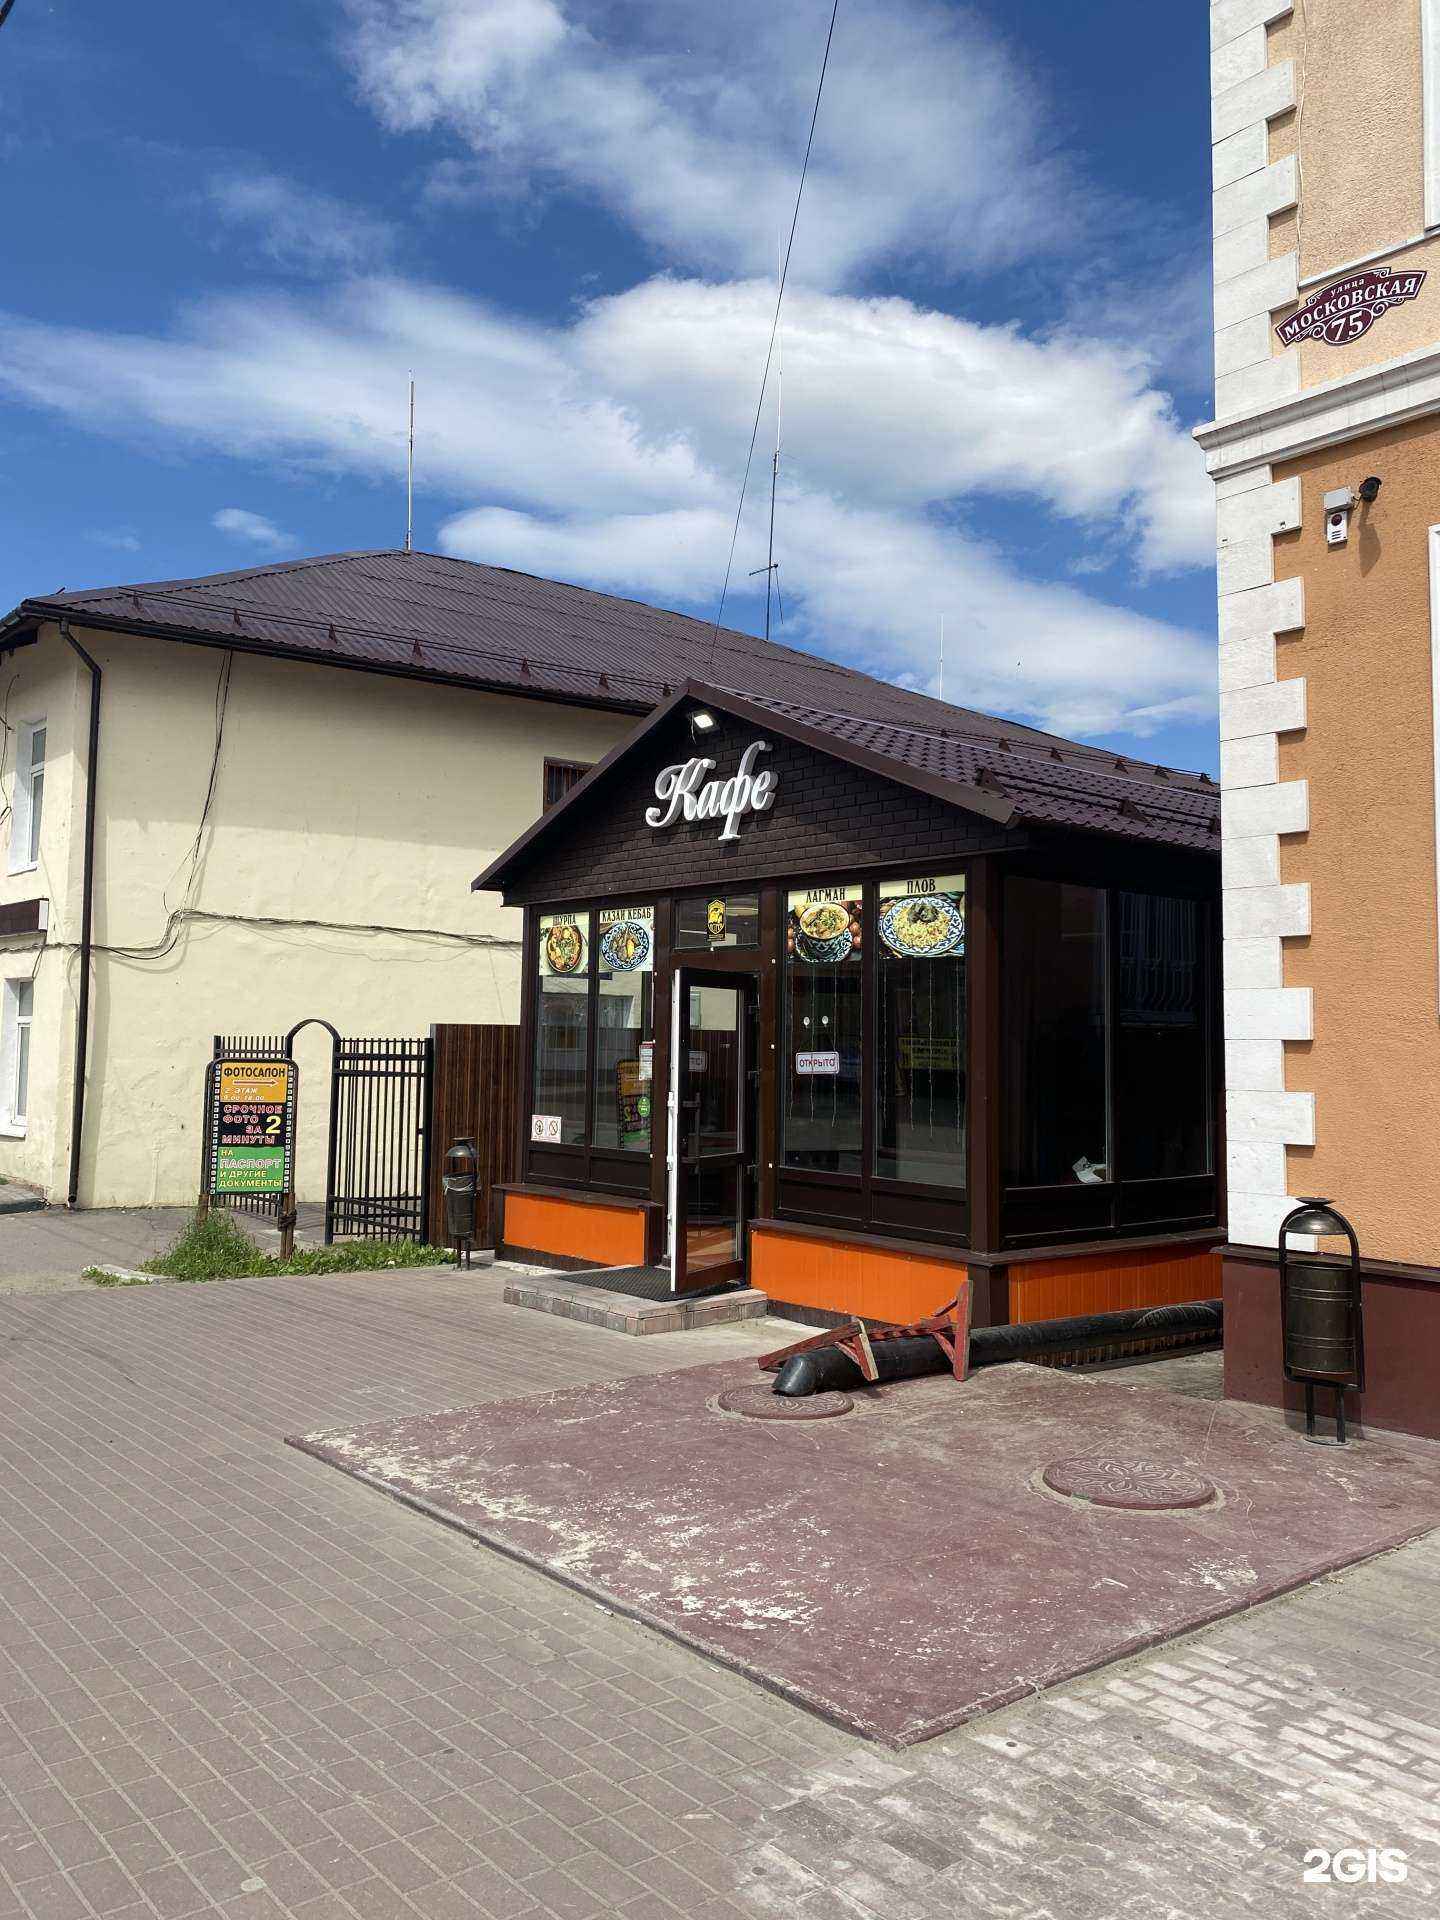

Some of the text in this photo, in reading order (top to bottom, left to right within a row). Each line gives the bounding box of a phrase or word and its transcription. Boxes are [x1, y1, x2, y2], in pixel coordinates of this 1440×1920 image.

[1330, 278, 1365, 298] улица
[1284, 277, 1418, 339] МОСКОВСКАЯ
[1330, 311, 1363, 341] 75
[645, 740, 778, 841] Кафе
[906, 878, 936, 894] ПЛОВ
[805, 888, 846, 903] ЛАГМАН
[602, 907, 652, 922] КАЗАН КЕБАБ
[799, 1057, 836, 1067] ОТКРЫТО
[224, 1066, 286, 1078] ФОТОСАЛОН
[223, 1104, 283, 1114] СРОЧНОЕ
[222, 1114, 259, 1124] ФОТО
[245, 1115, 282, 1134] ЗА 2
[221, 1134, 275, 1145] МИНУТЫ
[219, 1158, 281, 1169] ПАСПОРТ
[220, 1170, 267, 1178] И ДРУГИЕ
[218, 1179, 282, 1188] ДОКУМЕНТЫ
